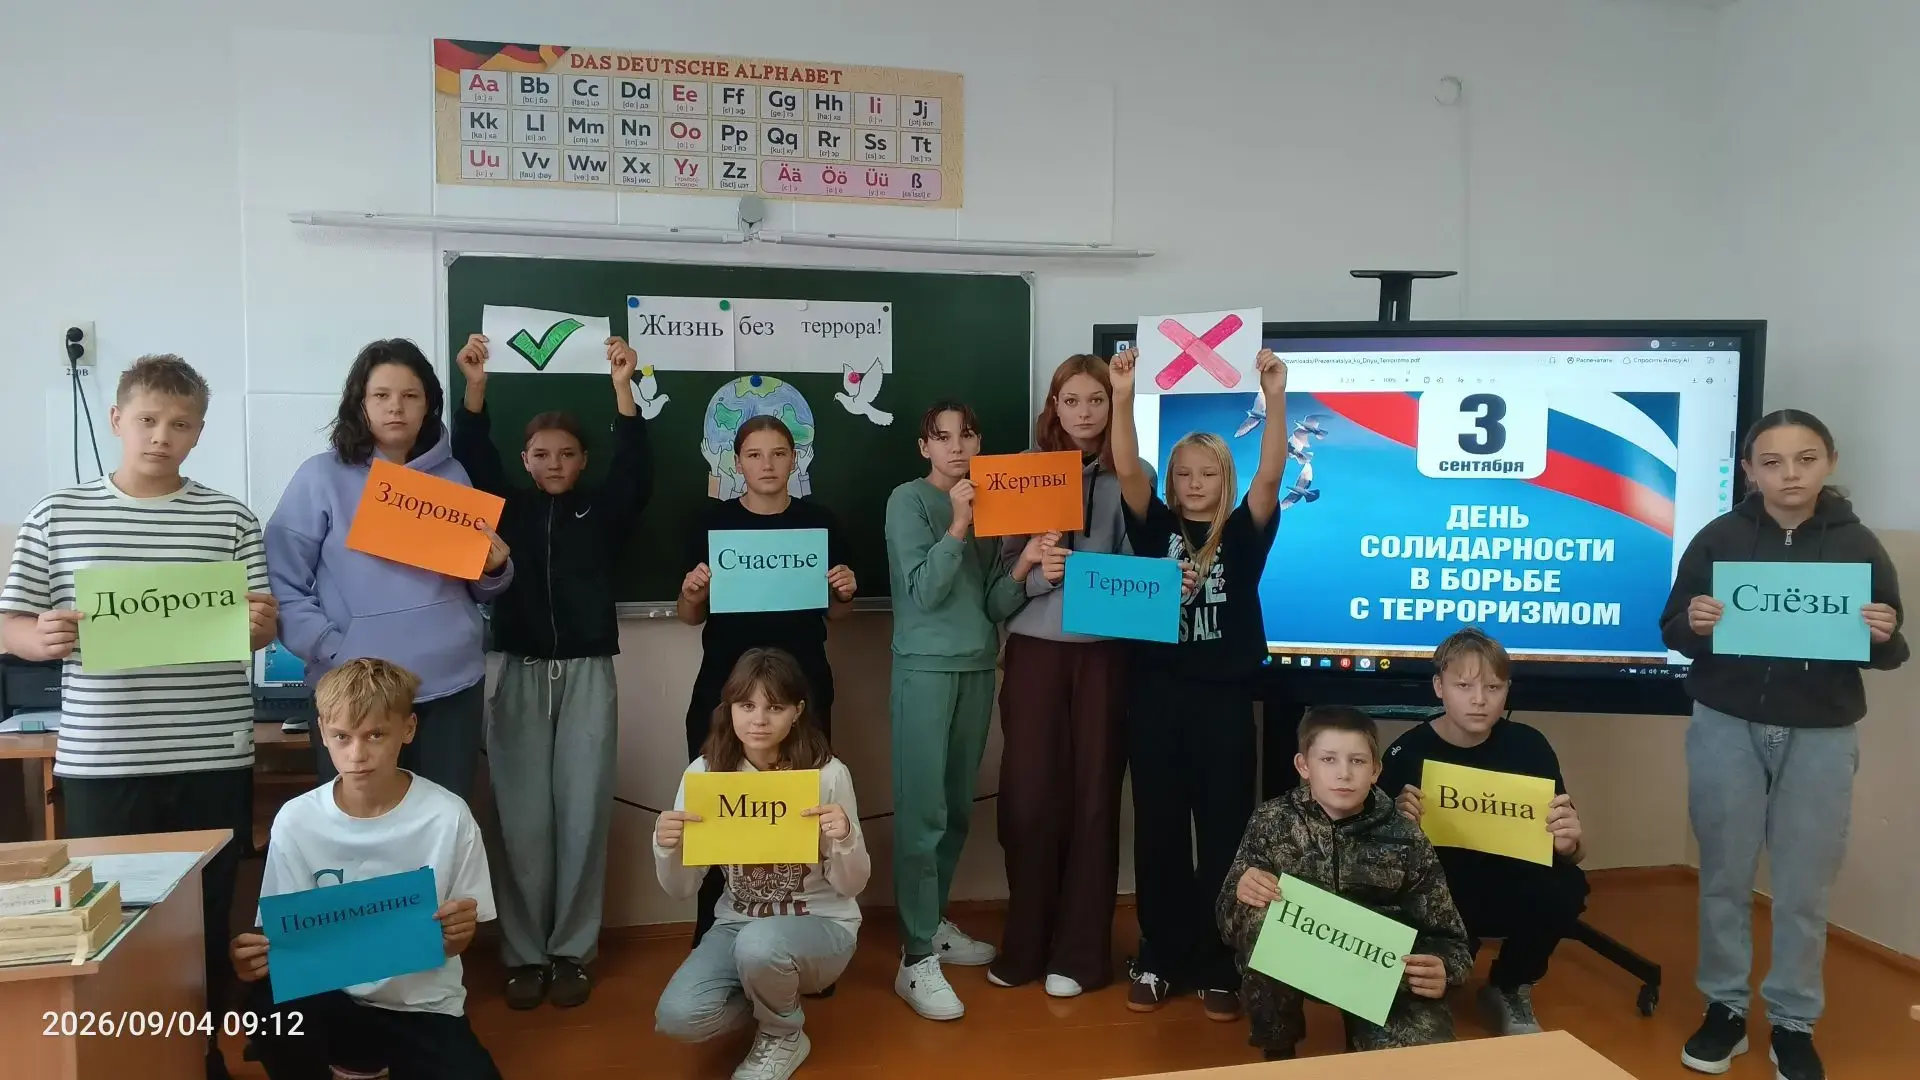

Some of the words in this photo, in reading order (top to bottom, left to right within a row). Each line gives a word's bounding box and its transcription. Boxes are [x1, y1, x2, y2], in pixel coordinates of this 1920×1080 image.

[570, 53, 611, 70] DAS
[617, 56, 729, 77] DEUTSCHE
[734, 63, 843, 85] ALPHABET
[469, 74, 499, 92] Aa
[520, 76, 549, 94] Bb
[573, 79, 599, 96] Cc
[621, 81, 650, 99] Dd
[673, 84, 698, 102] Ee
[723, 88, 745, 104] Ff
[768, 91, 796, 111] Gg
[815, 94, 843, 111] Hh
[913, 100, 928, 119] Jj
[470, 112, 499, 129] Kk
[527, 114, 544, 131] Ll
[568, 117, 604, 134] Mm
[622, 119, 651, 136] Nn
[670, 122, 701, 139] Oo
[722, 125, 748, 145] Pp
[767, 127, 797, 150] Qq
[818, 130, 841, 147] Rr
[865, 133, 887, 150] Ss
[911, 136, 931, 153] Tt
[470, 150, 499, 167] Uu
[521, 152, 550, 169] Vv
[568, 155, 607, 172] Ww
[622, 156, 651, 174] Xx
[674, 158, 698, 177] Yy
[723, 161, 747, 179] Zz
[778, 163, 802, 182] Ää
[822, 165, 848, 184] Öö
[865, 168, 889, 187] Üü
[911, 173, 922, 189] ß
[639, 314, 724, 337] Жизнь
[739, 315, 774, 336] без
[800, 318, 882, 338] террора!
[1458, 393, 1507, 455] 3
[1439, 459, 1524, 474] сентября
[986, 473, 1067, 493] Жертвы
[374, 481, 486, 531] Здоровье
[1446, 504, 1529, 530] ДЕНЬ
[1360, 535, 1615, 562] СОЛИДАРНОСТИ
[718, 548, 818, 570] Счастье
[1085, 570, 1160, 599] Террор
[1411, 567, 1430, 590] В
[1441, 567, 1561, 593] БОРЬБЕ
[92, 588, 236, 623] Доброта
[1732, 584, 1850, 615] Слёзы
[1350, 597, 1369, 620] С
[1380, 597, 1620, 626] ТЕРРОРИЗМОМ
[1193, 606, 1222, 641] ALL
[717, 793, 787, 825] Мир
[1438, 784, 1536, 820] Война
[280, 893, 421, 933] Понимание
[1276, 900, 1397, 969] Насилие
